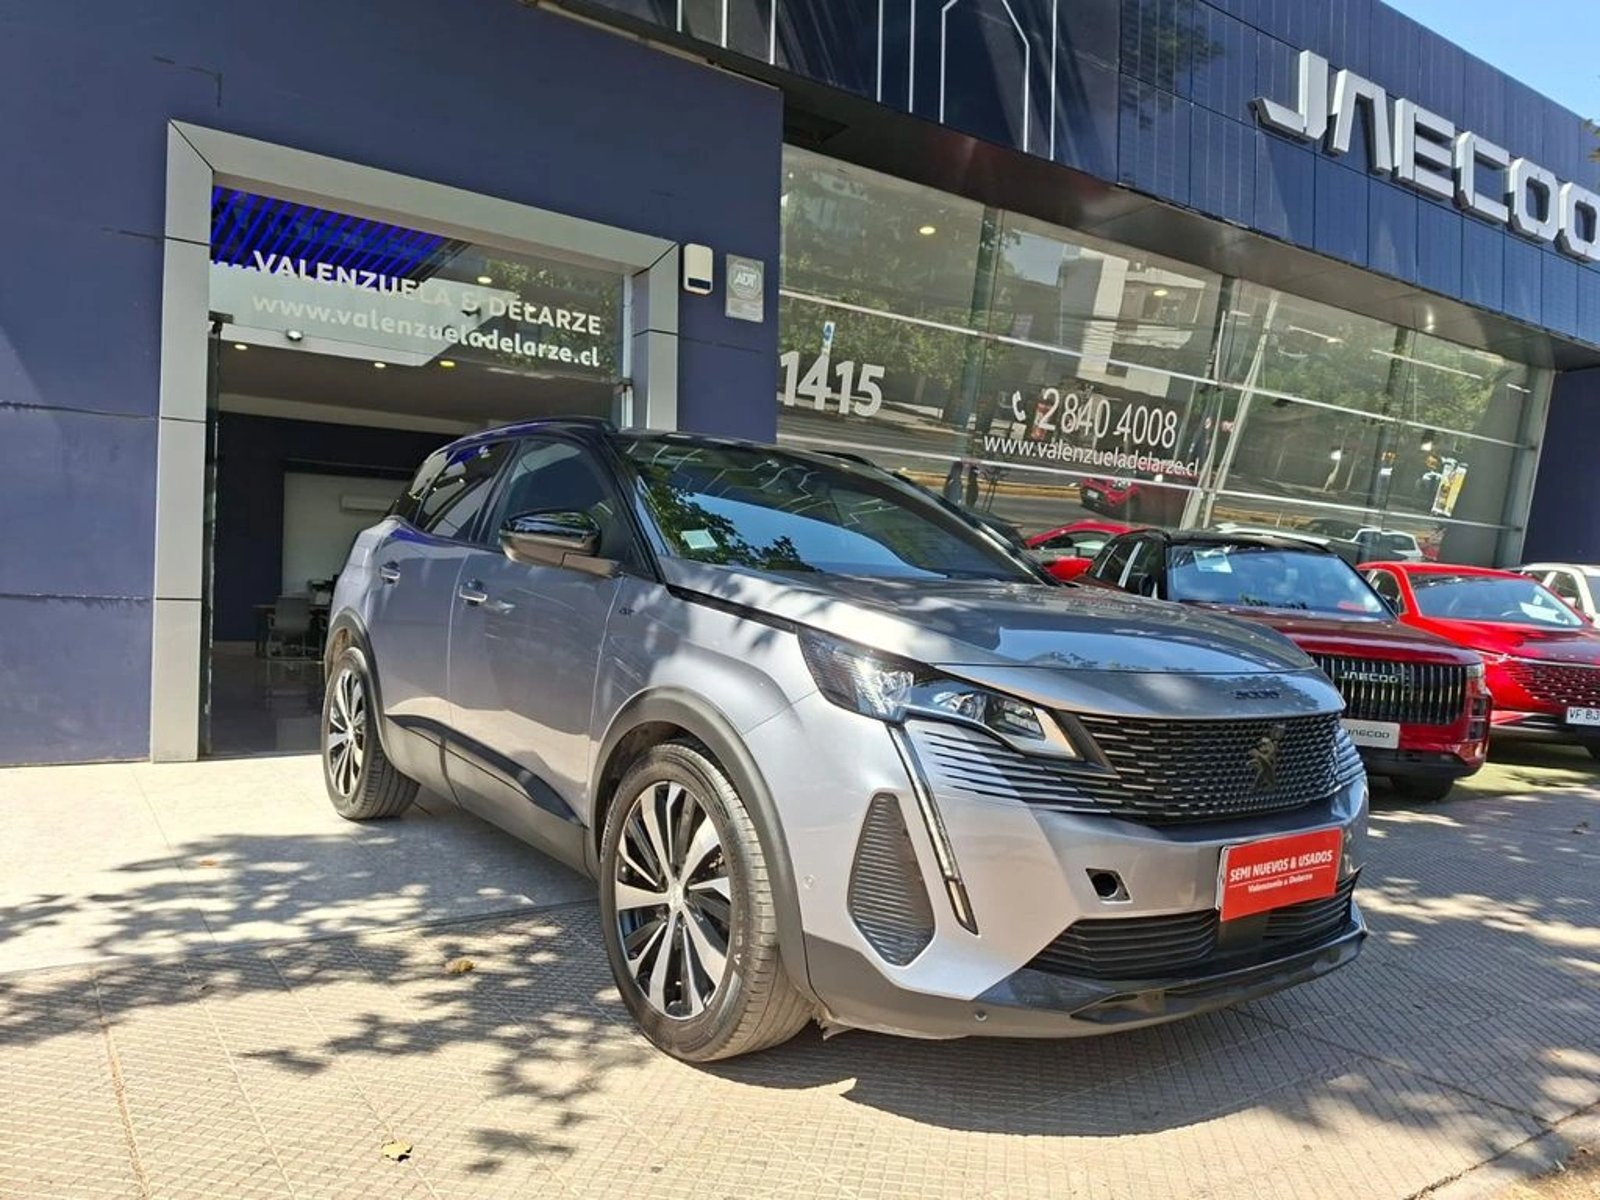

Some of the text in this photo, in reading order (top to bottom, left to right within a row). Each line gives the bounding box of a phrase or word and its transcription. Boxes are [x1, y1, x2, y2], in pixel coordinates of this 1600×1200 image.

[1249, 49, 1600, 262] JAECOO
[253, 251, 450, 305] VALENZUELA
[488, 295, 601, 335] DELARZE
[253, 295, 600, 367] www.valenzueladelarze.cl
[779, 351, 885, 417] 1415
[984, 435, 1198, 476] www.valenzueladelarze.cl
[1339, 671, 1398, 684] JAECOO
[1229, 866, 1252, 882] SEMI
[1252, 857, 1289, 876] NUEVOS
[1298, 849, 1333, 868] USADOS
